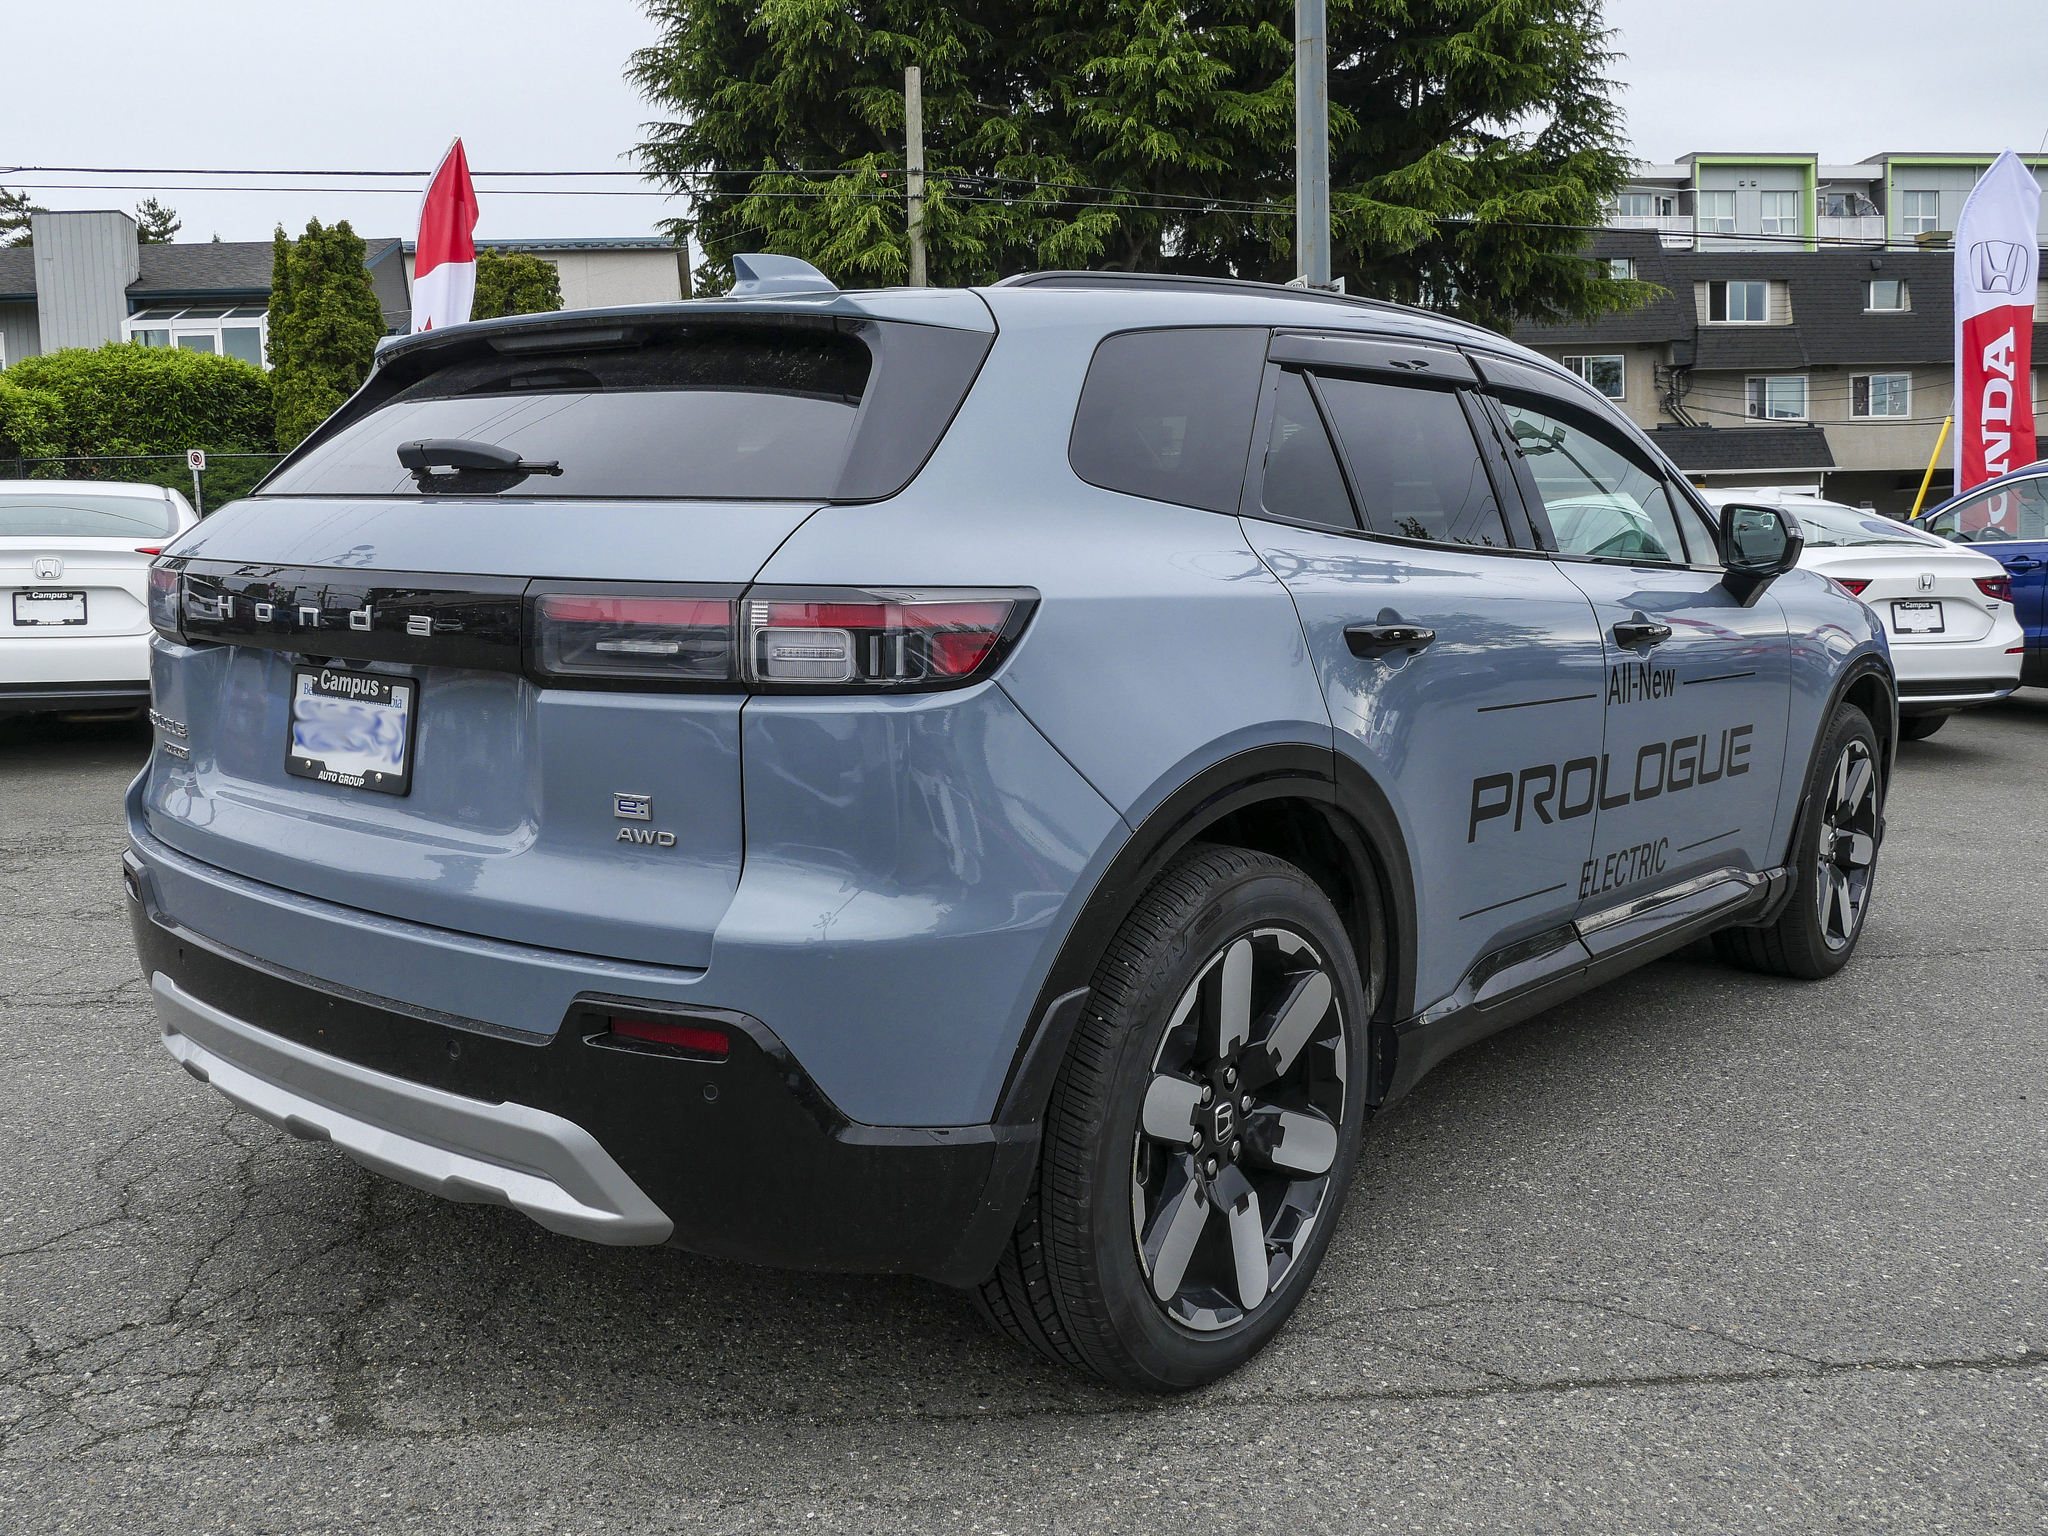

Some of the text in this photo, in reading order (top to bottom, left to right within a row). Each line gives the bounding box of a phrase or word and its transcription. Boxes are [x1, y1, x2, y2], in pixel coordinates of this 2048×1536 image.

[1981, 326, 2014, 533] ONDA
[32, 592, 68, 600] Campus
[217, 595, 434, 638] Honda
[320, 669, 379, 698] Campus
[1607, 662, 1675, 705] All-New
[318, 770, 365, 787] AUTO GROUP
[1467, 724, 1753, 843] PROLOGUE
[616, 827, 677, 847] AWD
[1578, 837, 1668, 900] ELECTRIC
